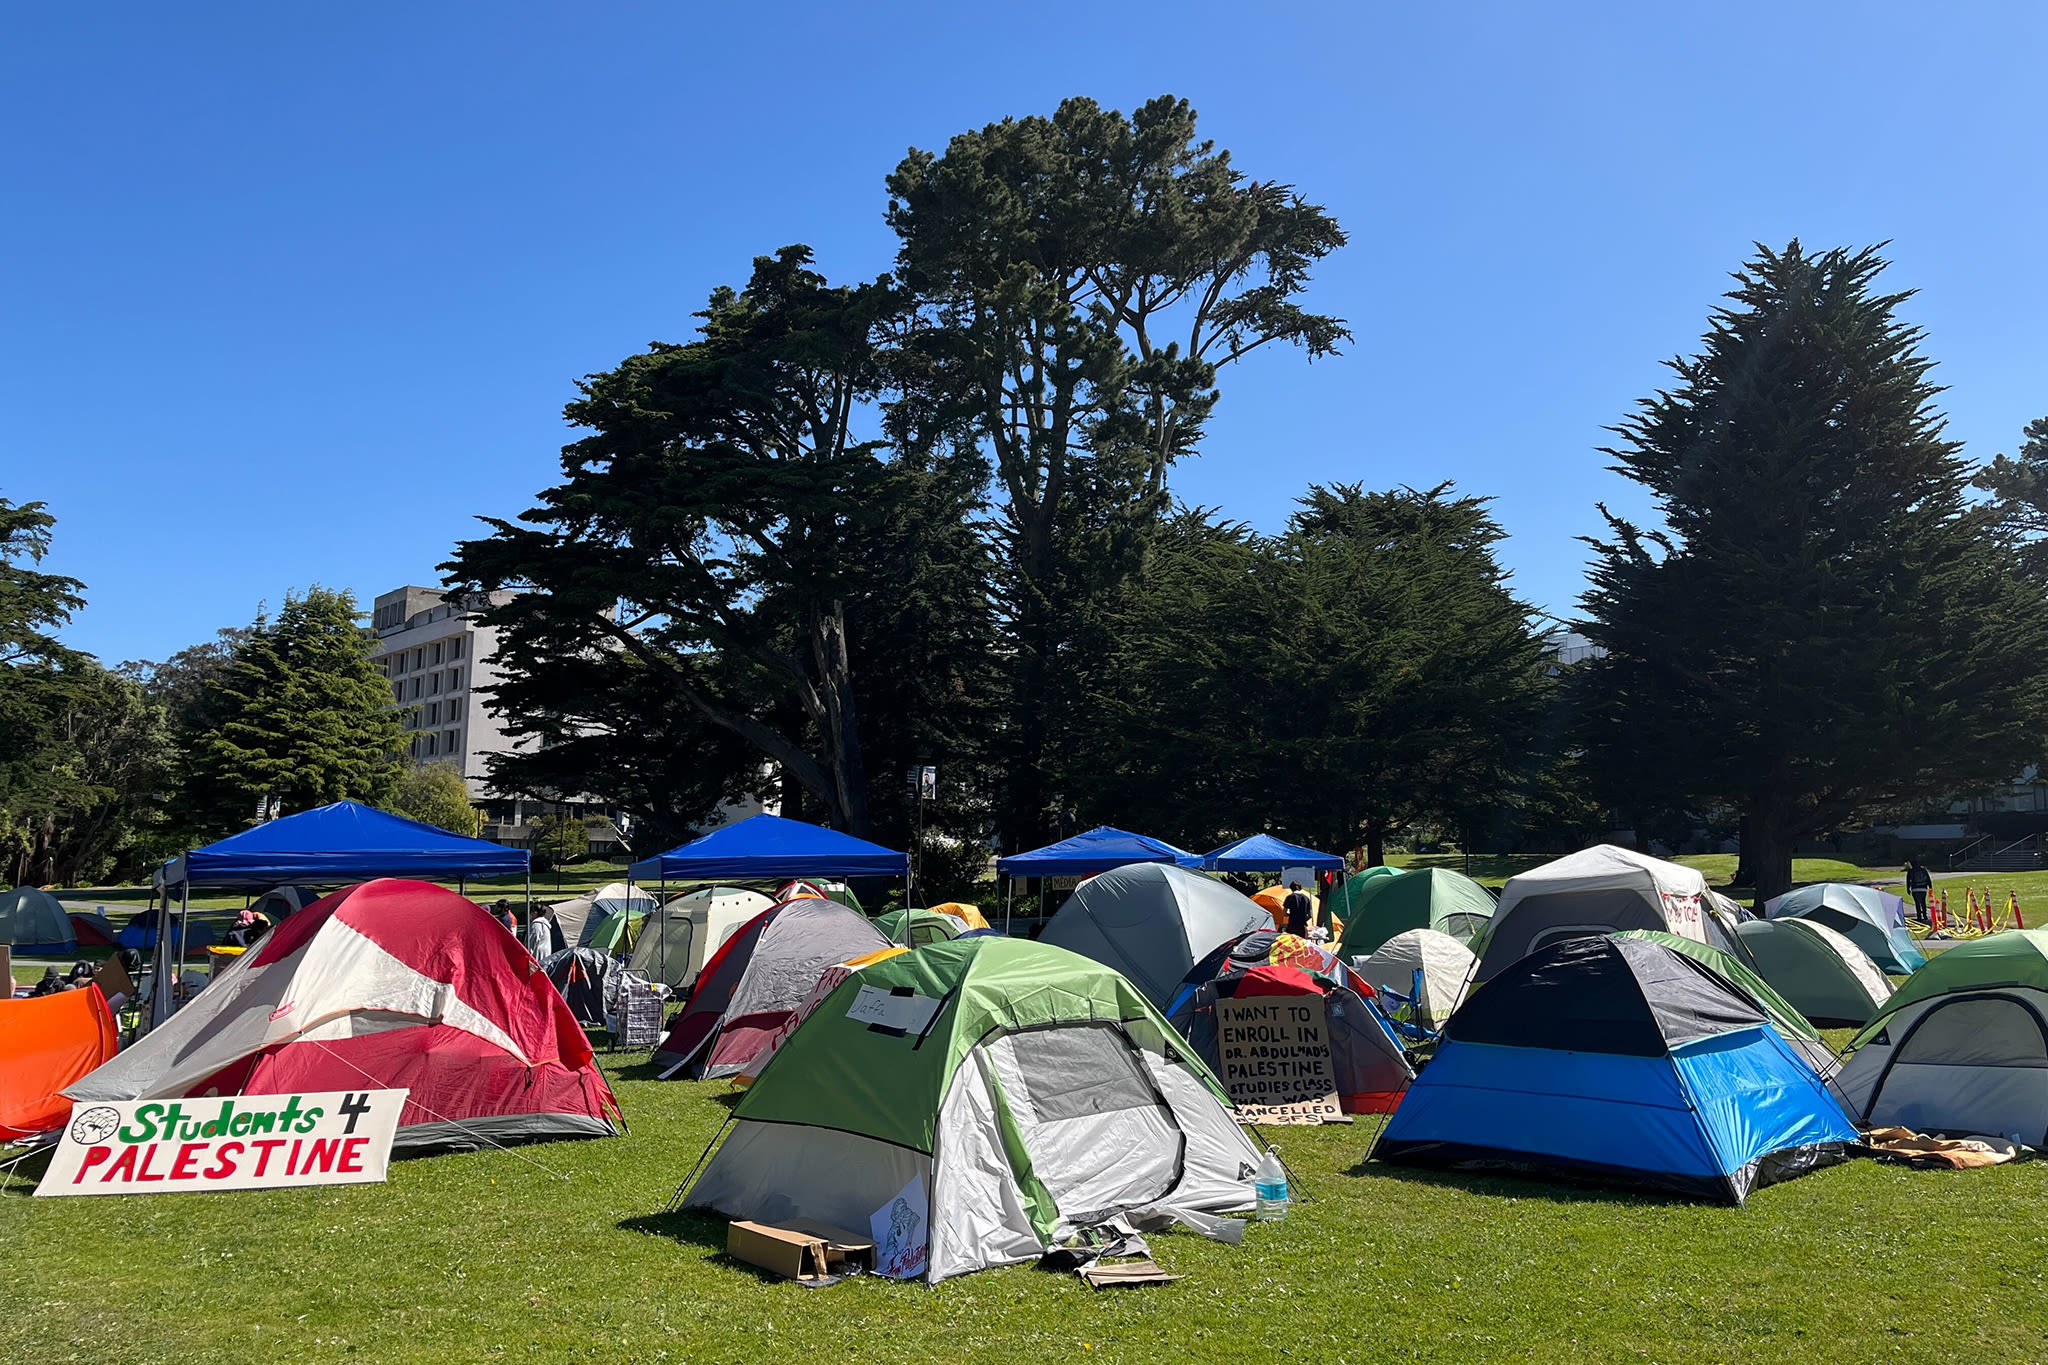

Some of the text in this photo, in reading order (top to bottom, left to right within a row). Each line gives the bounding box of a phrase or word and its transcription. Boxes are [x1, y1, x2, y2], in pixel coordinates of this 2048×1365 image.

[1223, 1005, 1311, 1022] I WANT TO
[1223, 1025, 1318, 1043] ENROLL IN
[1225, 1047, 1247, 1059] DR.
[1227, 1061, 1324, 1079] PALESTINE
[1230, 1079, 1333, 1095] STUDIES CLASS
[1282, 1092, 1325, 1105] WAS
[118, 1093, 372, 1144] Students 4
[1233, 1105, 1336, 1117] CANCELLED
[72, 1137, 370, 1185] PALESTINE
